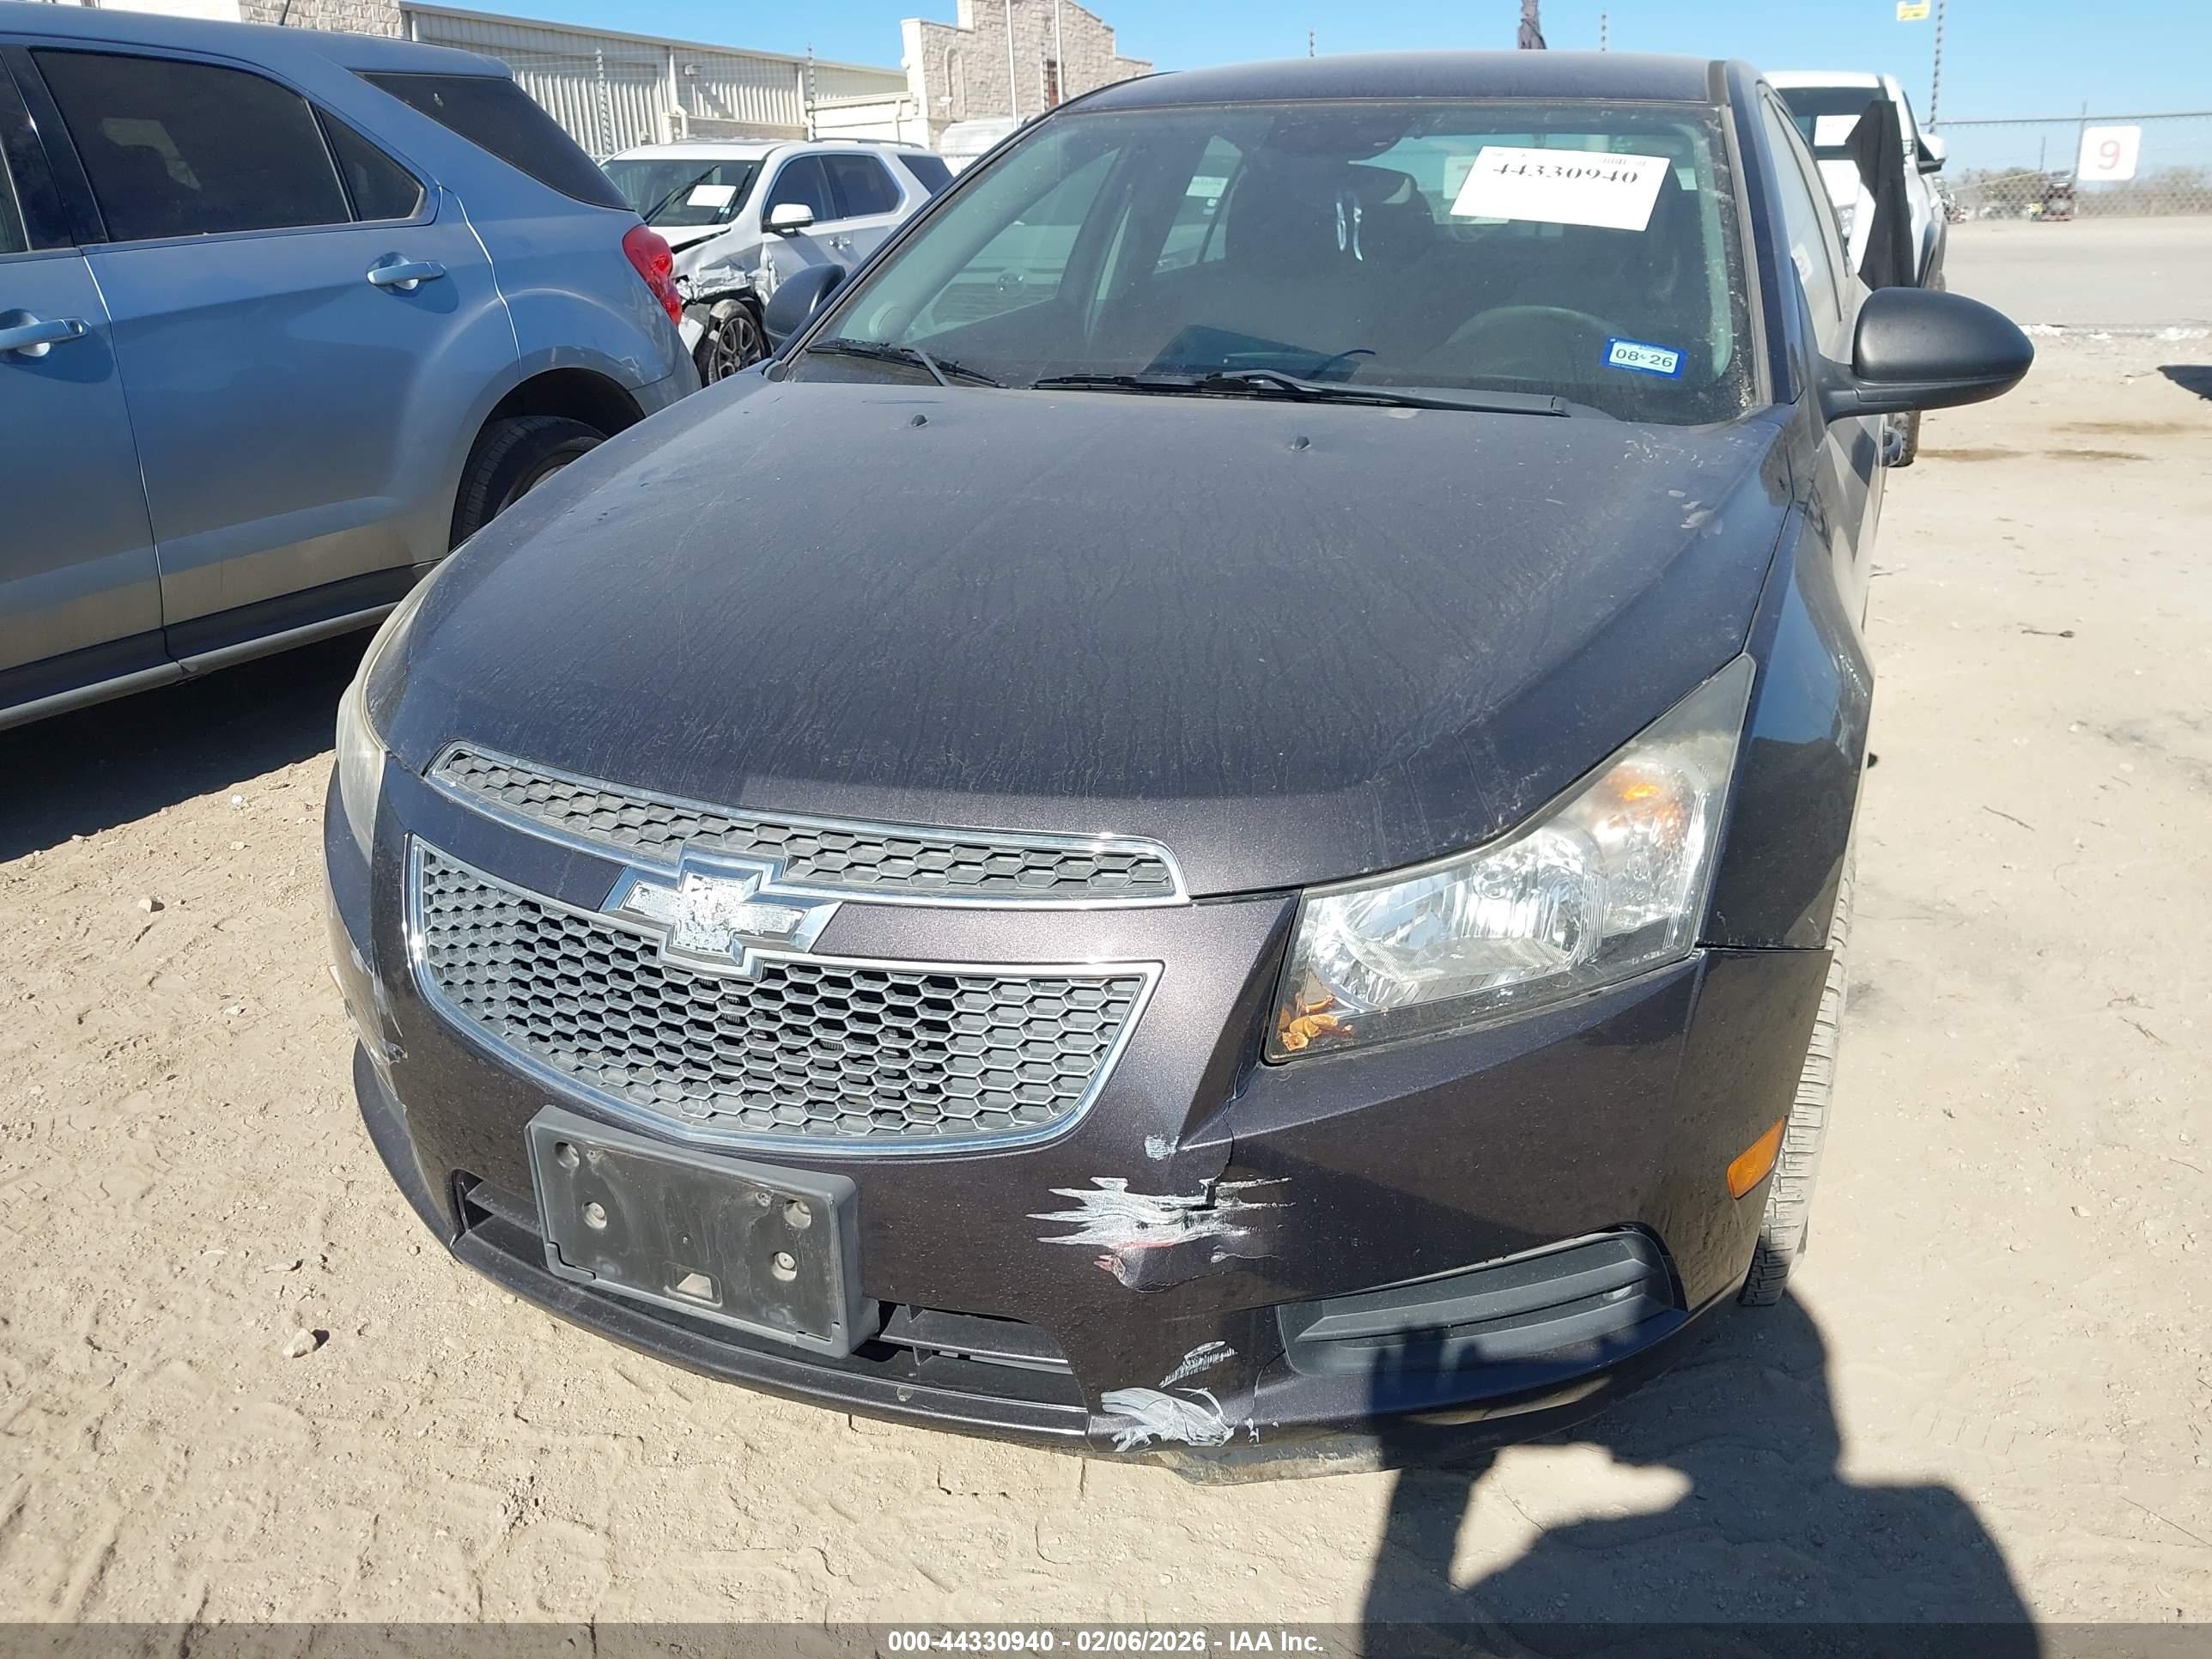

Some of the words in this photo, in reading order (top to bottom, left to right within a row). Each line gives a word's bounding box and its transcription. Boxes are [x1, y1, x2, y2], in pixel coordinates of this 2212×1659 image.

[2098, 139, 2121, 170] 9
[1492, 163, 1638, 184] 44330940
[1616, 349, 1639, 361] 08
[1650, 355, 1673, 368] 26
